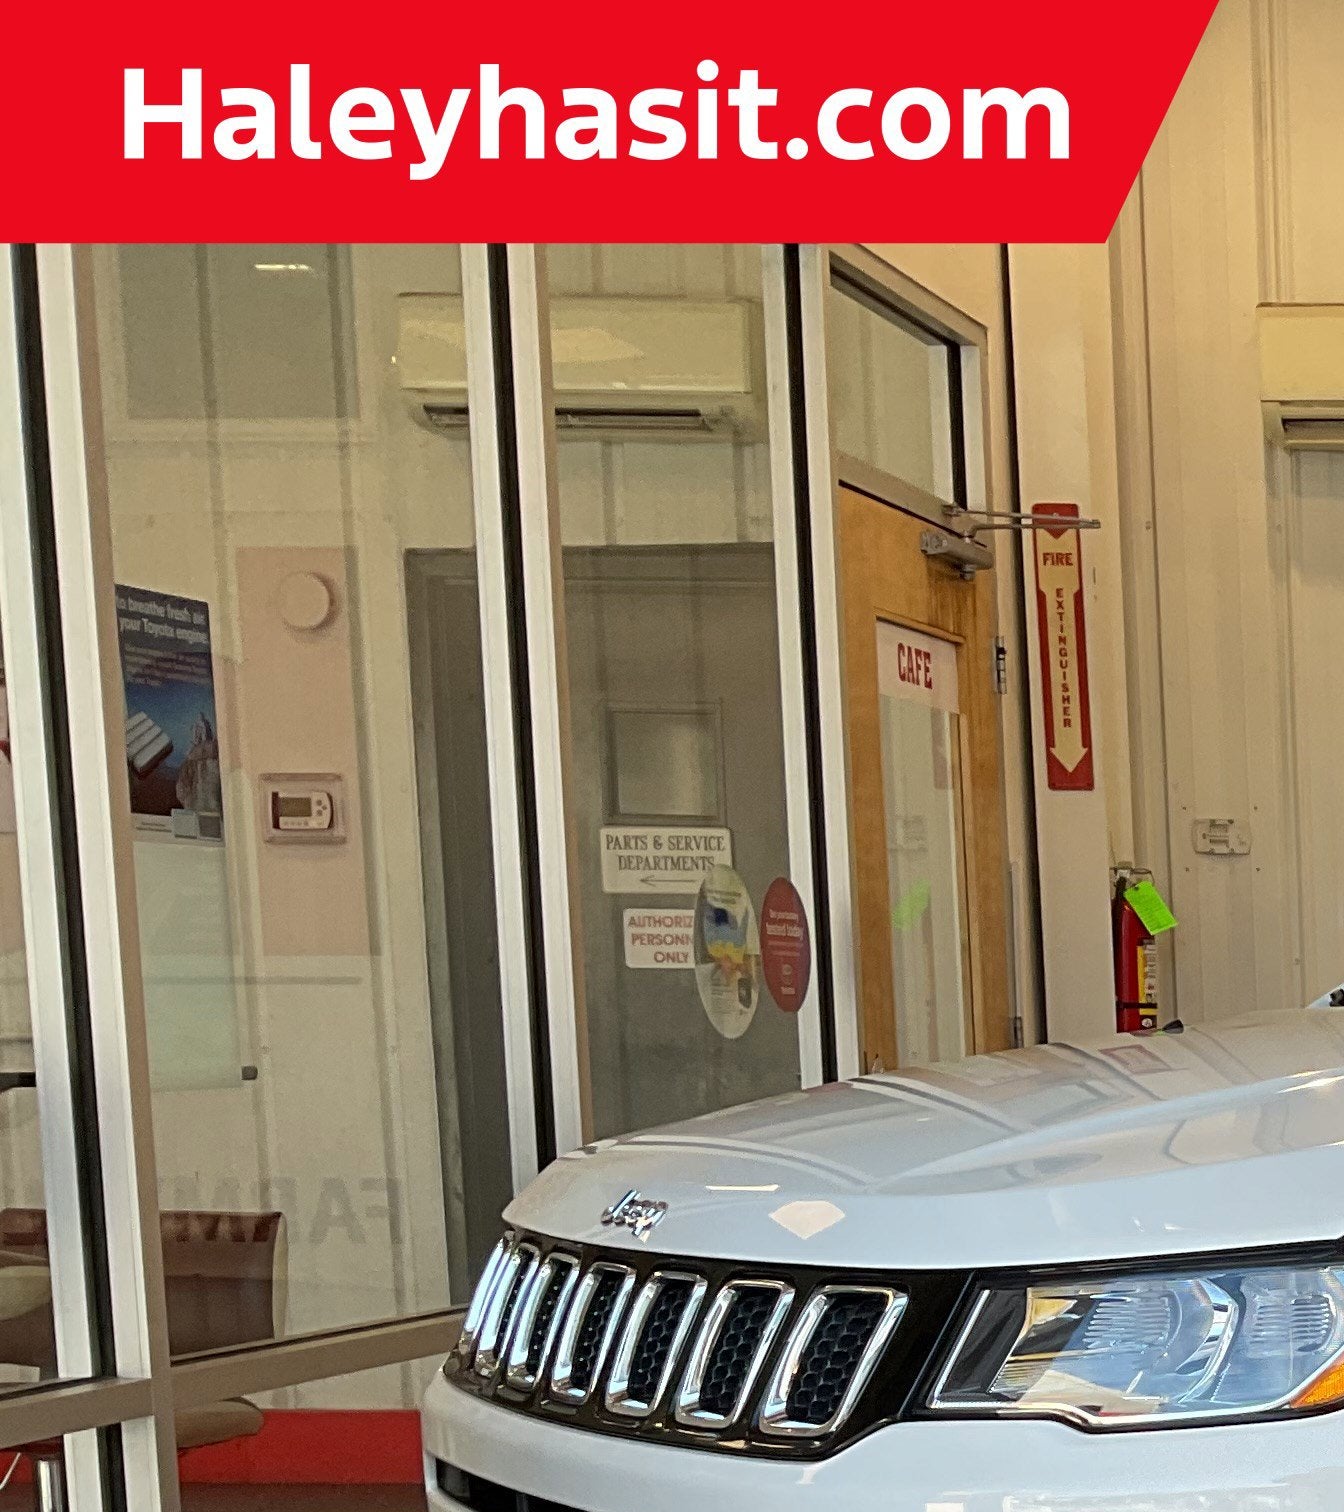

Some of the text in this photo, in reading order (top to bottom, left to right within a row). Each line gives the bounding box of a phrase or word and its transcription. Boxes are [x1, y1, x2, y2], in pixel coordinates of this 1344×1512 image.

[1043, 552, 1073, 566] FIRE
[897, 643, 933, 691] CAFE
[1056, 588, 1071, 728] EXTINGUISHER
[606, 834, 726, 852] PARTS & SERVICE
[618, 855, 715, 872] DEPARTMENTS
[653, 950, 690, 964] ONLY
[601, 1188, 669, 1238] Jeep
